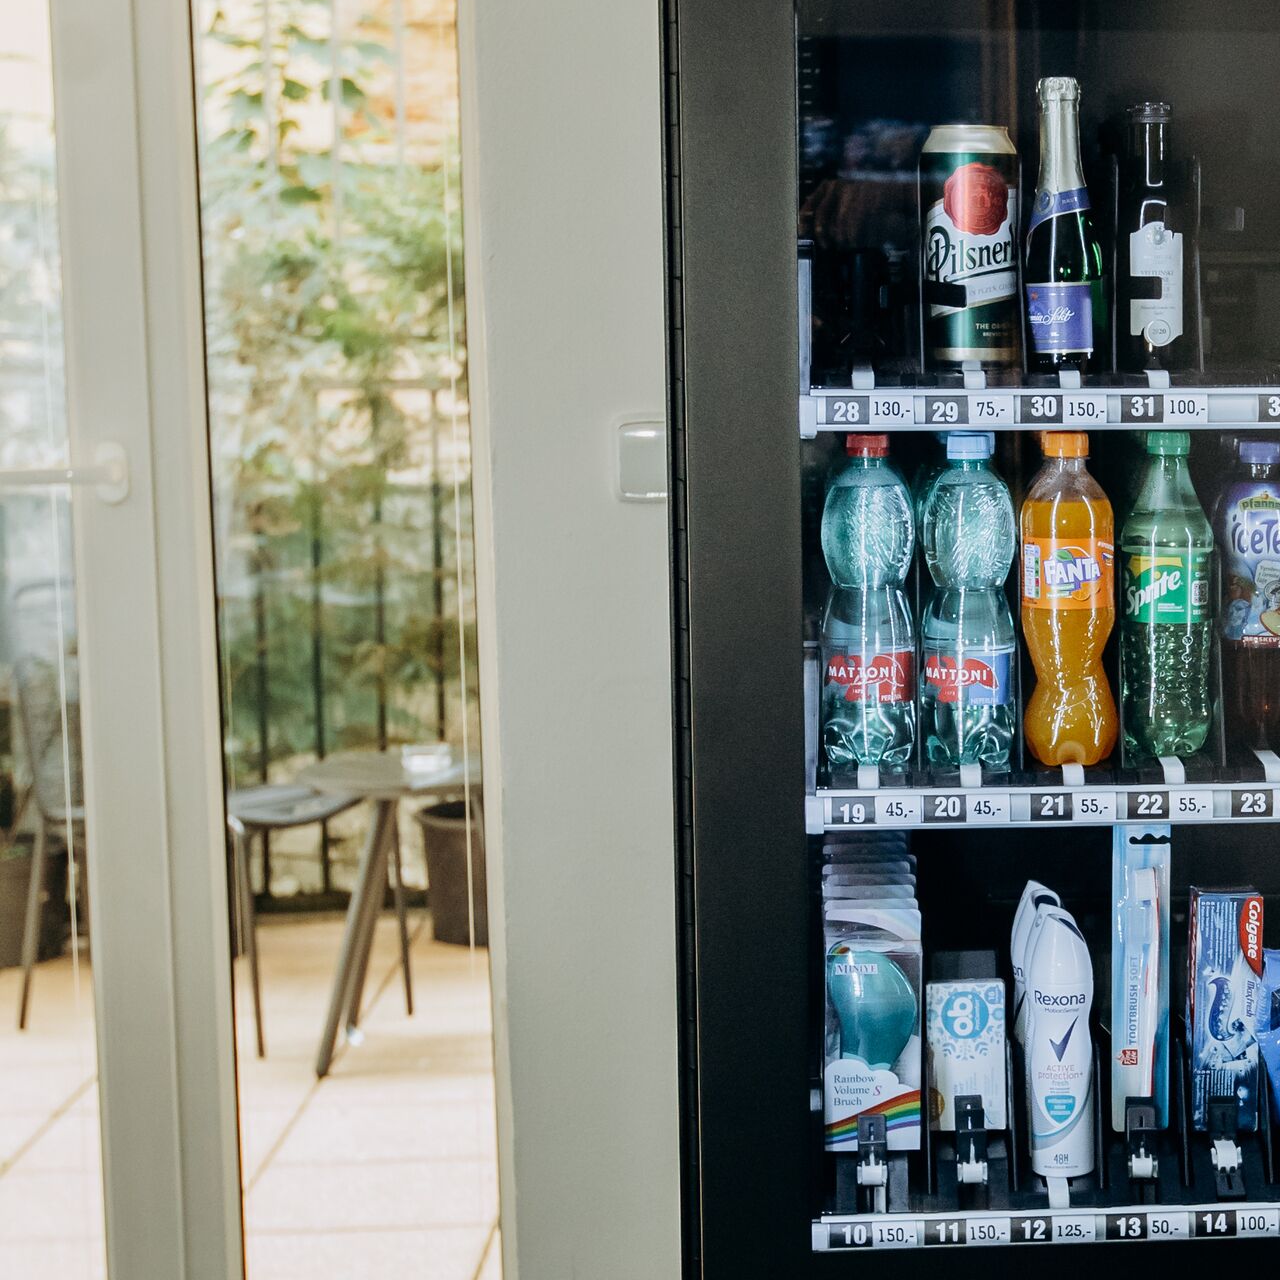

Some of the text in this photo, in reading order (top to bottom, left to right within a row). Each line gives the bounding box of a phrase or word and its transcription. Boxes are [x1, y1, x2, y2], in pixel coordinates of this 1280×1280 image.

[928, 225, 1012, 282] Pilsner
[833, 401, 911, 422] 28 130,-
[932, 401, 1005, 422] 29 75,-
[1031, 396, 1105, 420] 30 150,-
[1131, 396, 1206, 417] 31 100,-
[1043, 557, 1101, 585] FANTA
[1126, 570, 1181, 616] Sprite
[828, 665, 897, 678] MATTONI
[926, 666, 988, 681] MATTONI
[840, 802, 914, 823] 19 45,-
[934, 796, 1002, 817] 20 45,-
[1040, 795, 1109, 816] 21 55,-
[1137, 794, 1207, 815] 22 55,-
[1240, 792, 1267, 813] 23
[1245, 900, 1261, 959] Colgate
[1034, 990, 1086, 1006] Rexona
[1129, 956, 1138, 1045] TOOTBRUSH SOFT
[1046, 1064, 1075, 1072] ACTIVE
[833, 1074, 876, 1084] Rainbow
[833, 1085, 882, 1096] Volume S
[833, 1097, 863, 1106] Bruch
[1053, 1154, 1069, 1165] 48H
[936, 1222, 1006, 1243] 11 150,-
[1021, 1219, 1092, 1240] 12 125,-
[1116, 1217, 1179, 1237] 13 50,-
[1202, 1213, 1275, 1233] 14 100,-
[842, 1224, 915, 1245] 10 150,-
